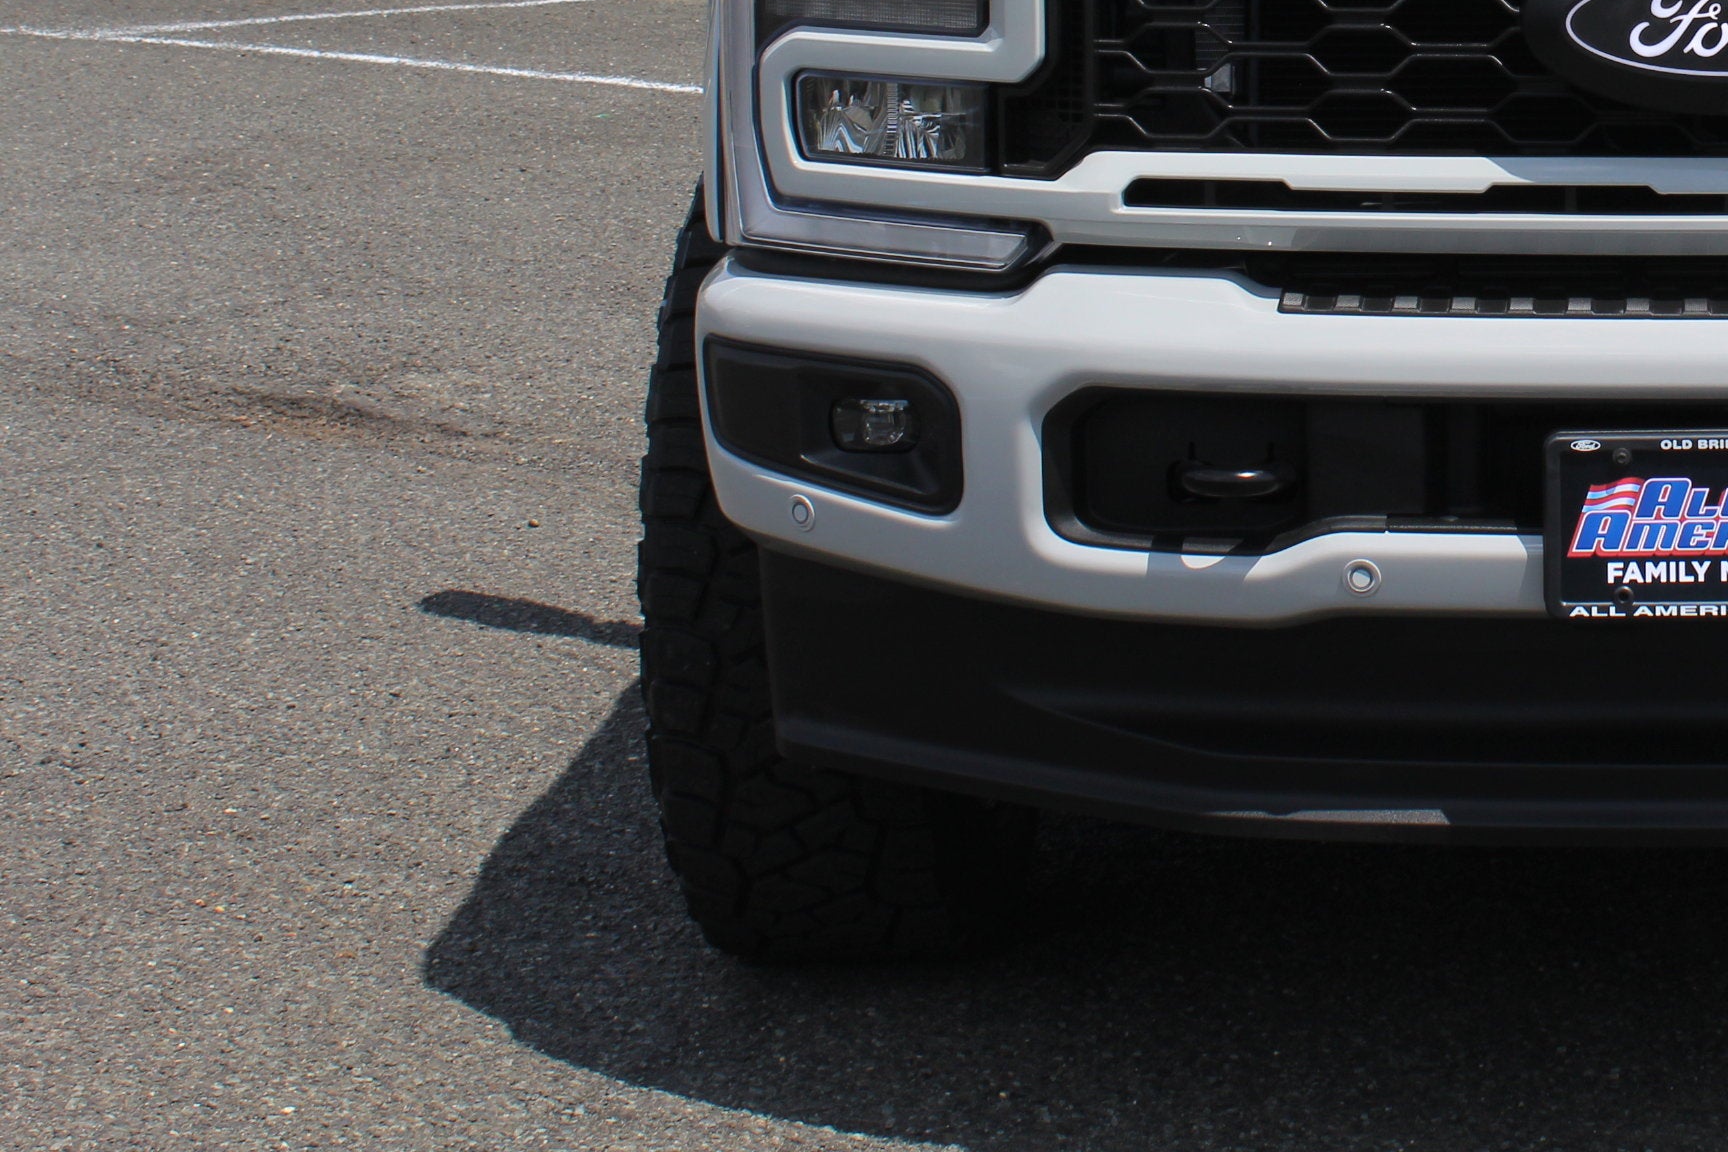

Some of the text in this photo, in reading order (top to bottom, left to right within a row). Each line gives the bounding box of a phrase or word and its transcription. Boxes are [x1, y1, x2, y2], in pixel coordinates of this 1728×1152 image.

[1660, 439, 1693, 450] OLD
[1607, 560, 1711, 583] FAMILY
[1569, 605, 1626, 617] ALL
